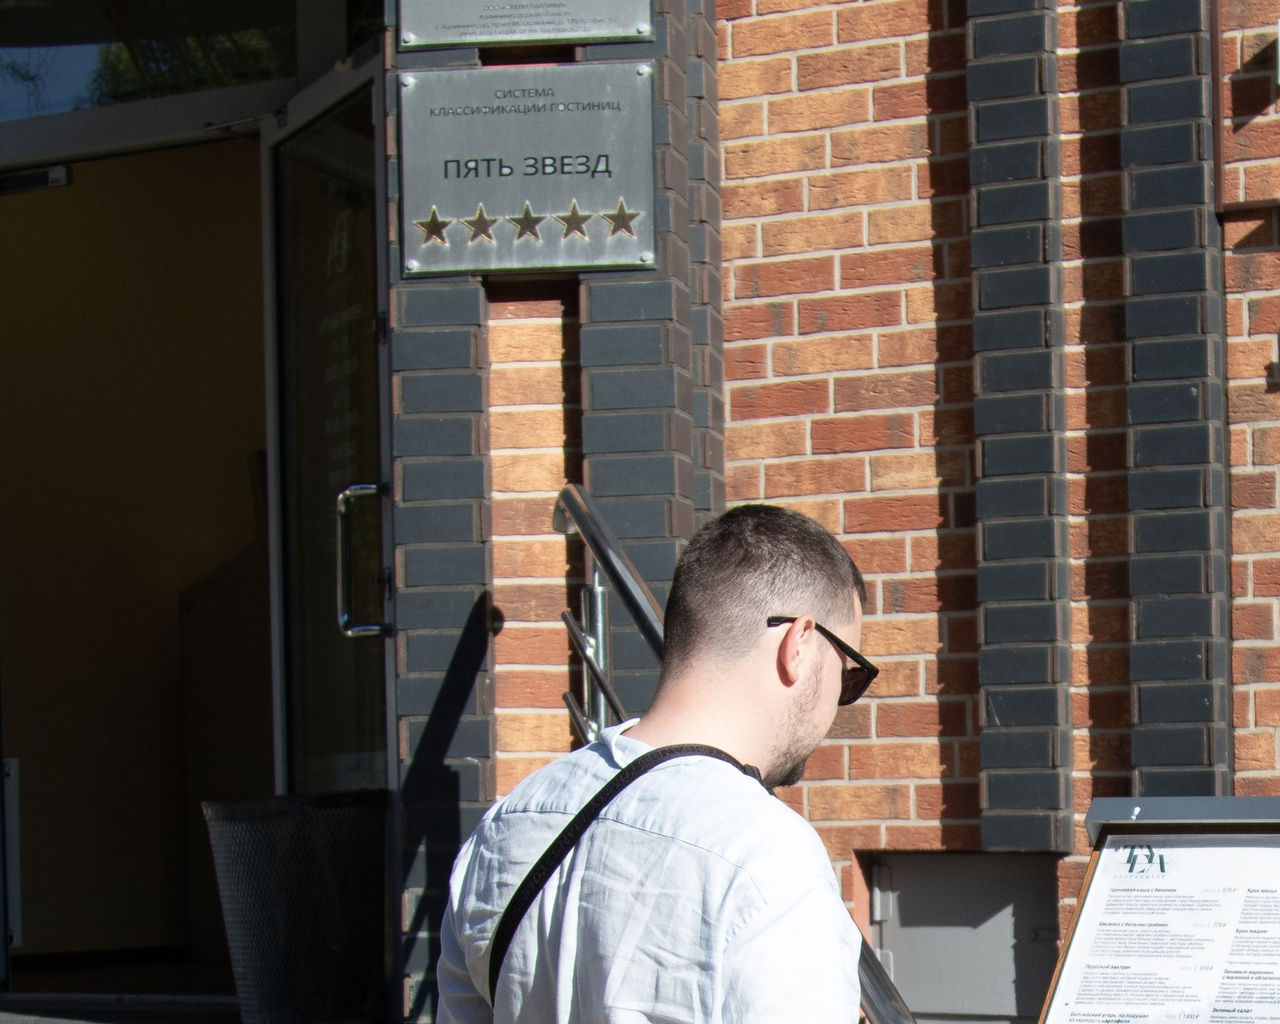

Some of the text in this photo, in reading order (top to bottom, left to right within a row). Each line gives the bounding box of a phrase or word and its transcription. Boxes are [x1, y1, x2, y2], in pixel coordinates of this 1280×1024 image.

[494, 87, 555, 99] СИСТЕМА
[429, 101, 621, 117] КЛАССИФИКАЦИИ ГОСТИНИЦ
[444, 154, 612, 179] ПЯТЬ ЗВЕЗД
